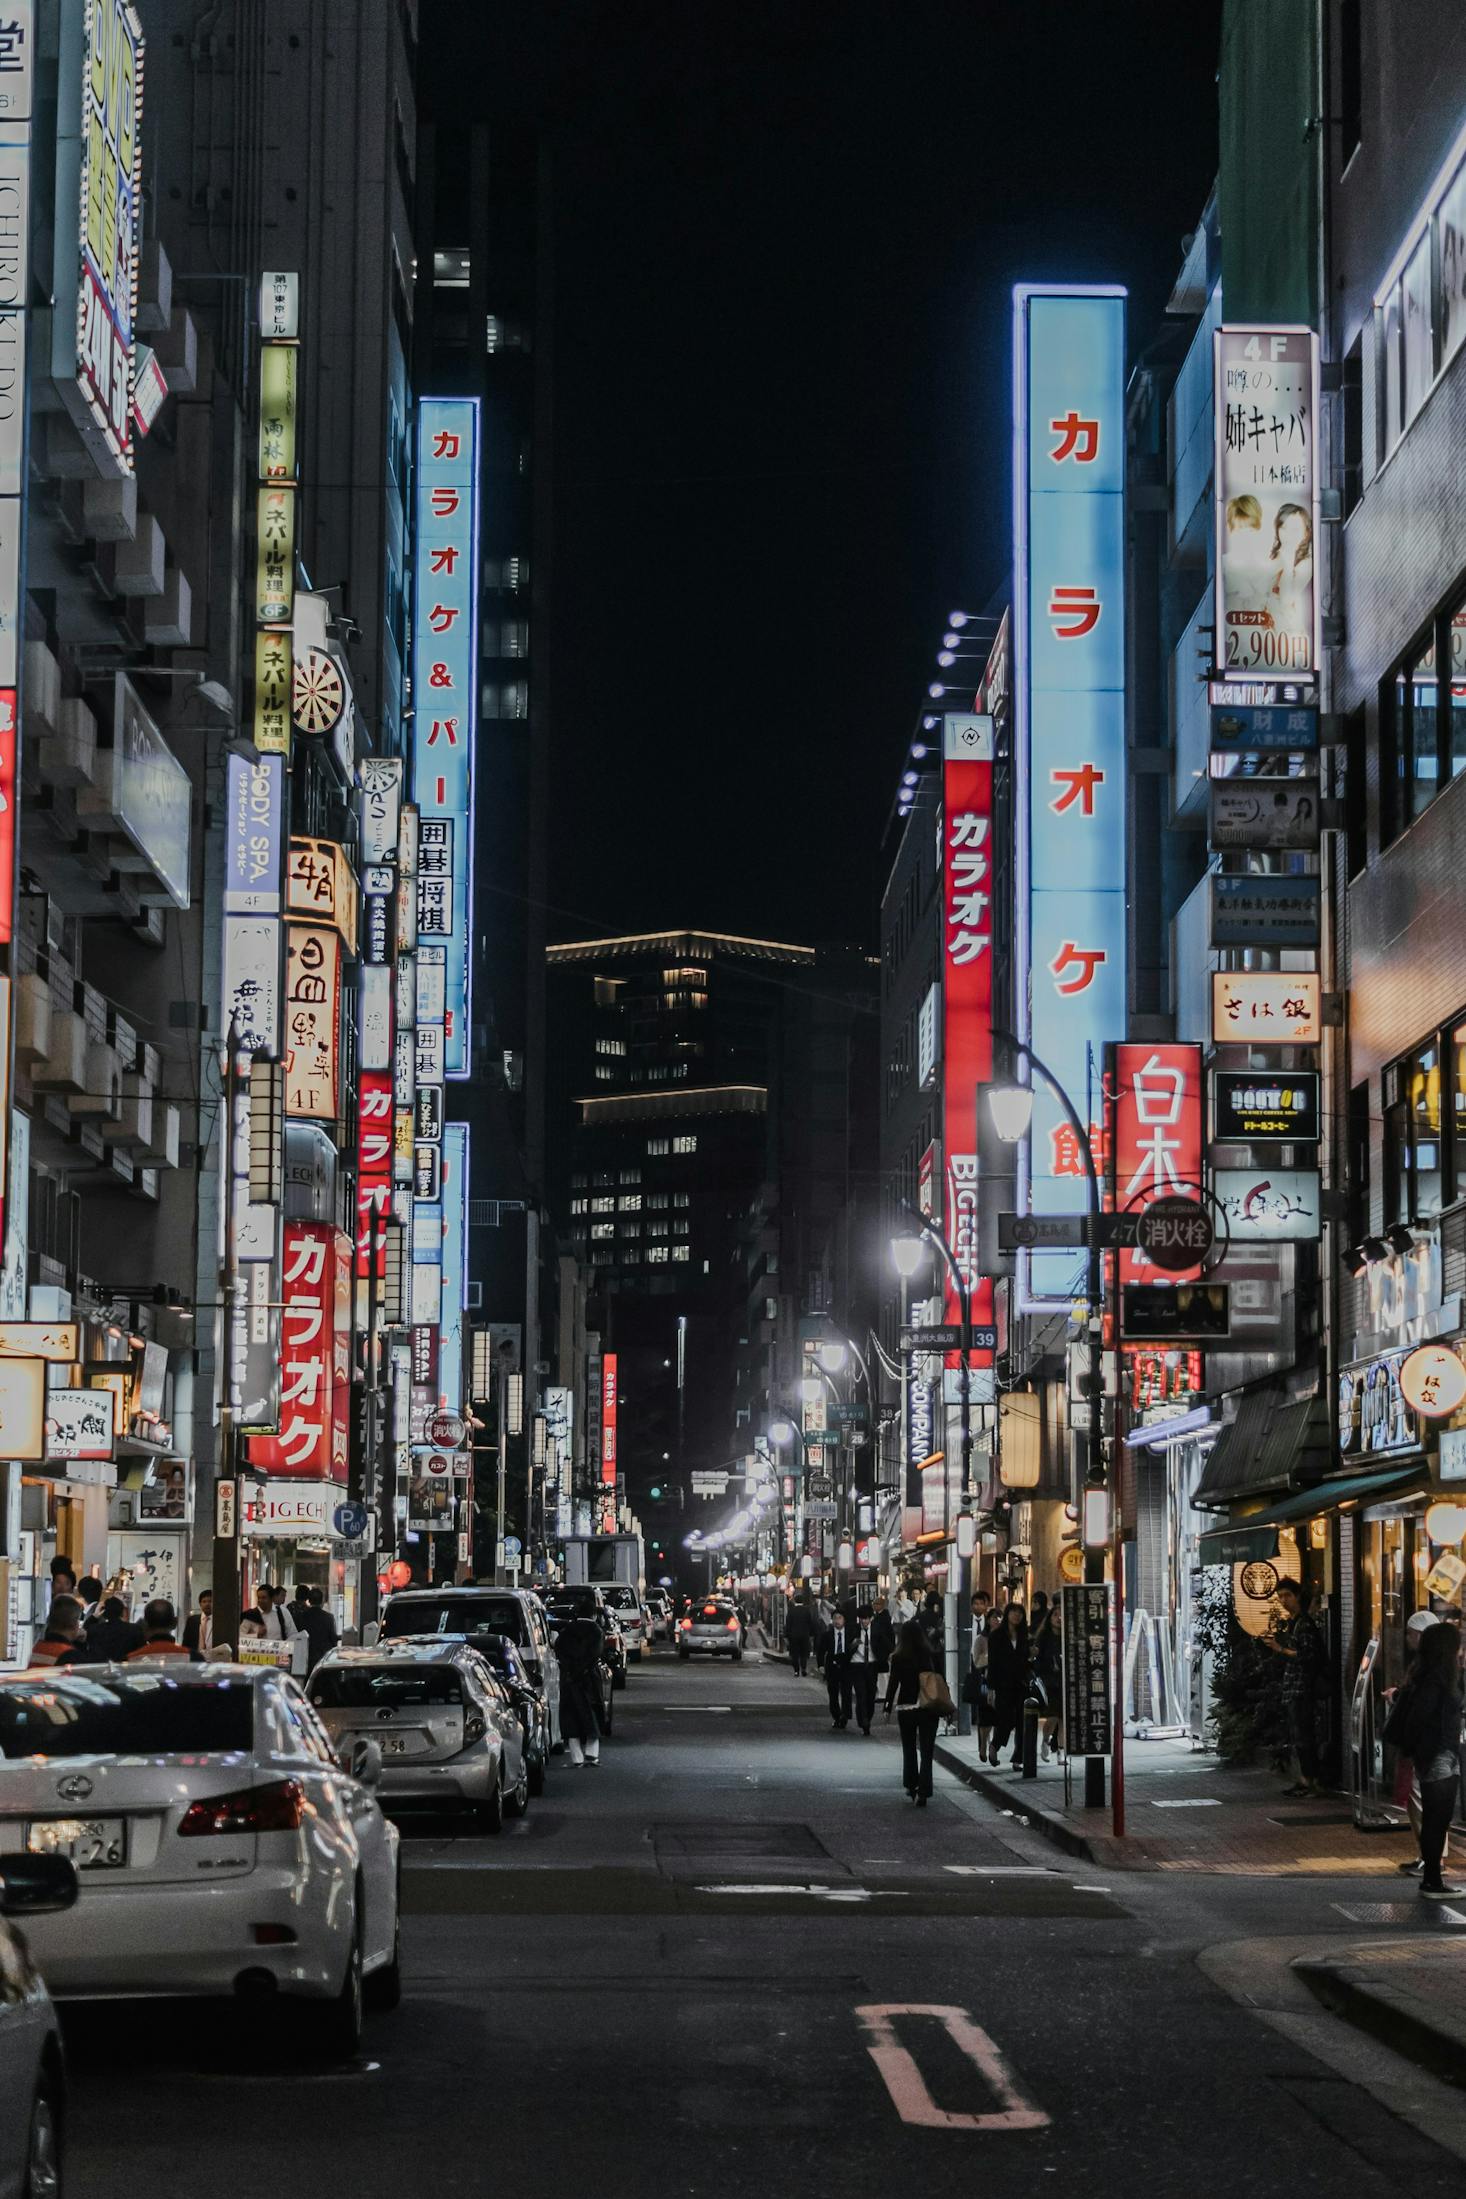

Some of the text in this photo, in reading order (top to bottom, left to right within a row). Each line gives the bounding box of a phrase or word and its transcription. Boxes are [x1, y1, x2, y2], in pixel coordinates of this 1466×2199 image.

[1244, 335, 1287, 361] 4F
[1225, 402, 1306, 454] 姉キャバ
[265, 509, 287, 592] ネパール料理
[264, 604, 283, 616] 6F
[1228, 630, 1309, 672] 2,900円
[262, 650, 285, 739] ネパール料理
[250, 764, 271, 827] BODY
[291, 855, 333, 903] 牛角
[418, 822, 448, 932] 囲碁将棋
[948, 813, 989, 966] カラオケ
[1217, 879, 1241, 890] 3F
[244, 895, 260, 906] 4F
[1294, 1025, 1312, 1035] 2F
[417, 1029, 438, 1074] 囲碁
[290, 1089, 320, 1110] 4F
[1231, 1089, 1305, 1110] DOUTOR
[1244, 1121, 1290, 1131] ドトールコーヒー
[949, 1155, 978, 1210] BIG
[1145, 1217, 1208, 1248] 消火栓
[278, 1234, 326, 1466] カラオケ
[421, 1327, 431, 1381] REGAL
[976, 1333, 994, 1346] 39
[880, 1408, 893, 1418] 38
[851, 1434, 863, 1444] 29
[221, 1499, 232, 1533] 高島屋
[247, 1501, 291, 1522] BIG
